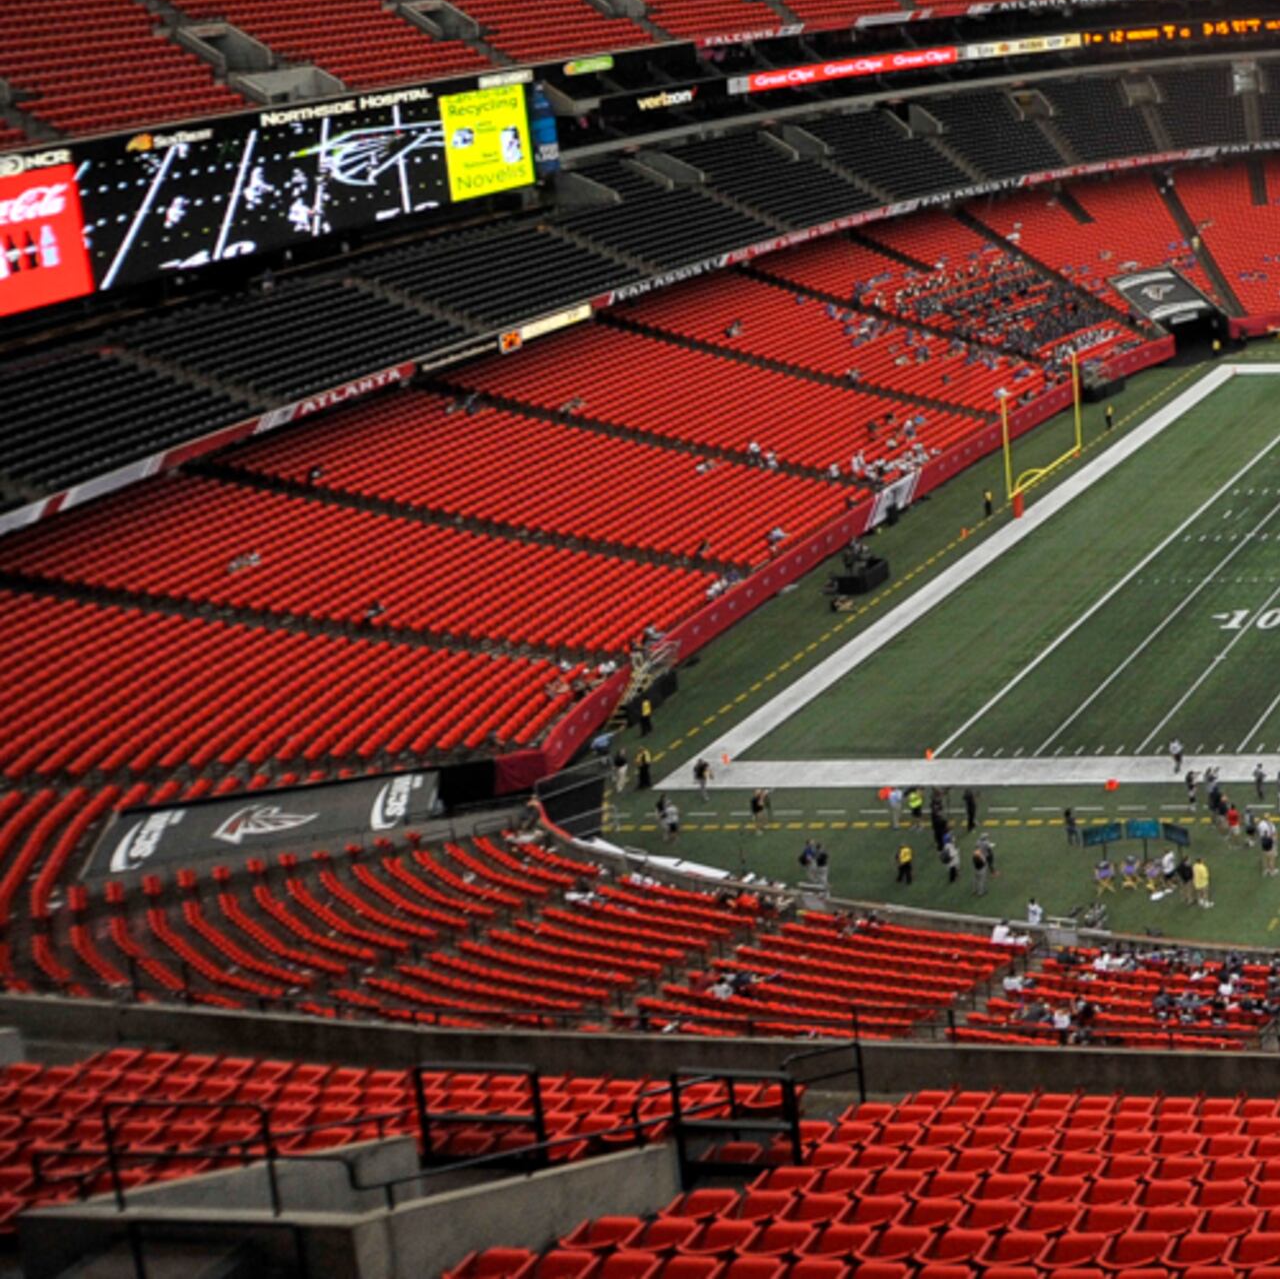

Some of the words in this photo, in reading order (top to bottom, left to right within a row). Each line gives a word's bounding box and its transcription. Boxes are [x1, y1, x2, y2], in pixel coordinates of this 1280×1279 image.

[1000, 0, 1066, 11] ATLANTA
[704, 30, 775, 47] FALCONS
[260, 100, 356, 127] NORTHSIDE
[360, 87, 433, 110] HOSPITAL
[637, 90, 692, 111] verizon
[456, 165, 528, 191] Novelis
[921, 191, 951, 207] FAN
[618, 283, 650, 300] FAN
[301, 368, 401, 414] ATLANTA
